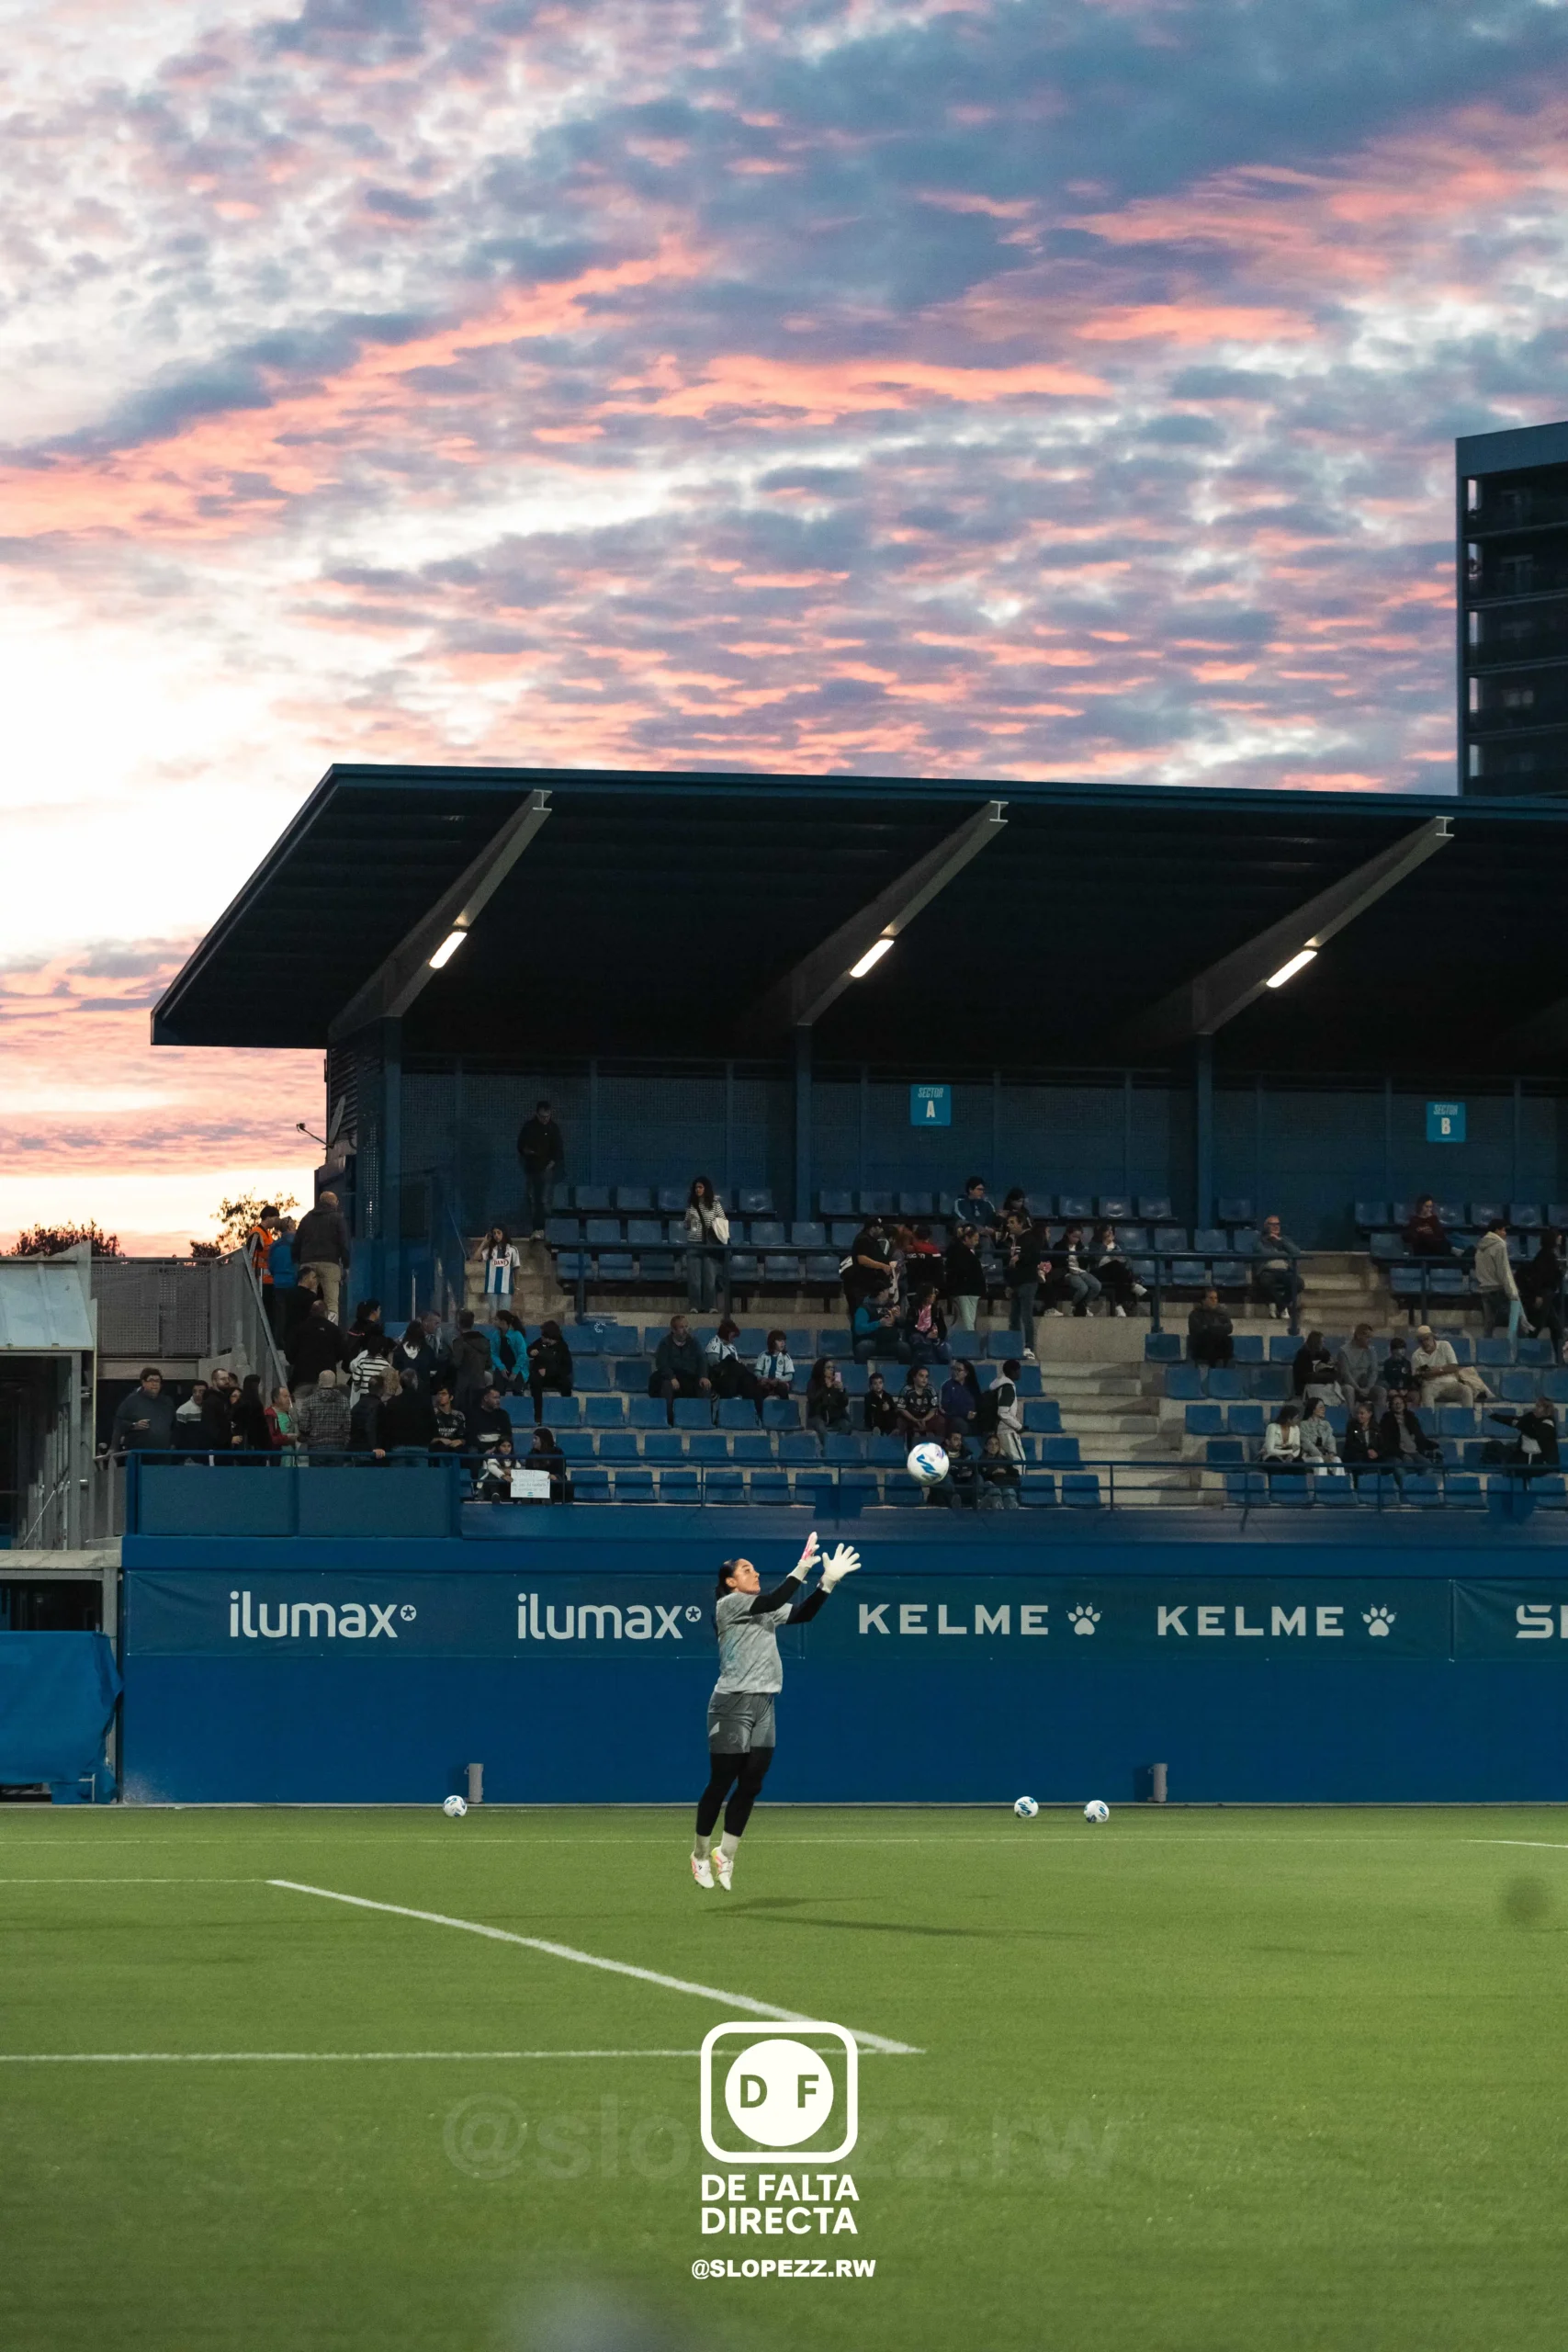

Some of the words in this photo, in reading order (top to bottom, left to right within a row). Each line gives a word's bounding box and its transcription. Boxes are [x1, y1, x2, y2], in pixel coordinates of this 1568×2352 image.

[918, 1087, 944, 1099] SECTOR
[926, 1100, 936, 1118] A
[1441, 1117, 1451, 1135] B
[230, 1590, 398, 1638] ilumax
[517, 1592, 683, 1640] ilumax
[859, 1603, 1049, 1635] KELME
[1157, 1606, 1344, 1636] KELME
[1515, 1604, 1568, 1639] S
